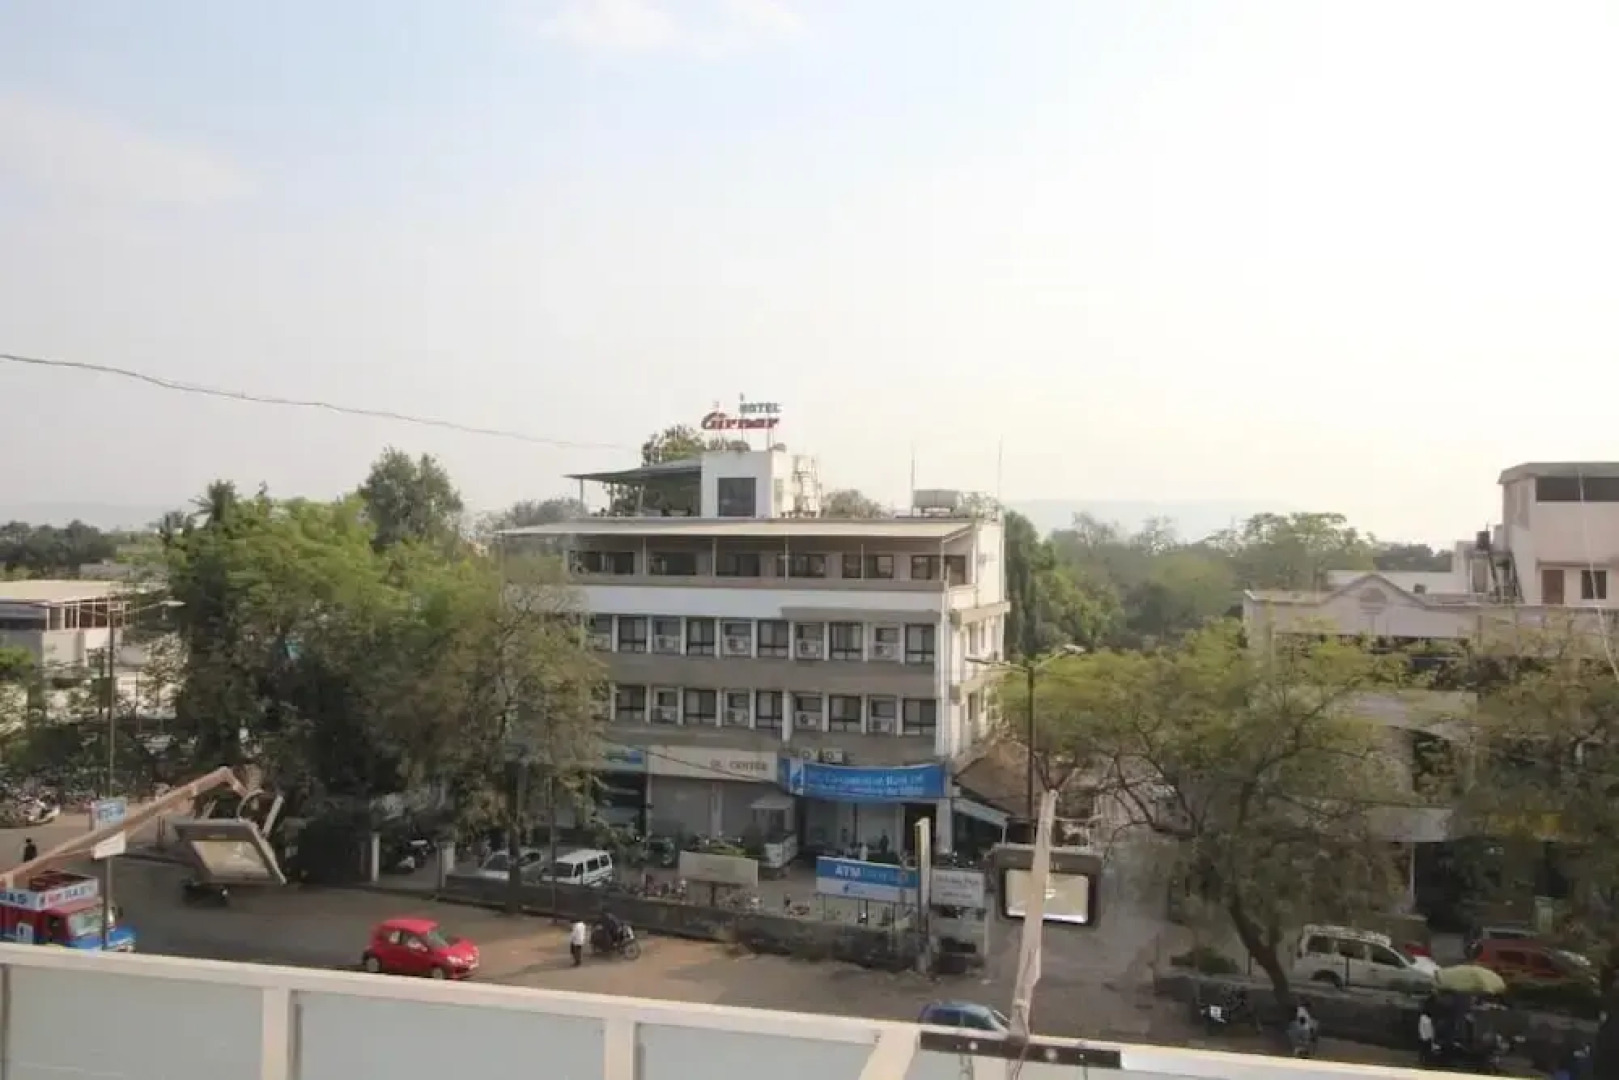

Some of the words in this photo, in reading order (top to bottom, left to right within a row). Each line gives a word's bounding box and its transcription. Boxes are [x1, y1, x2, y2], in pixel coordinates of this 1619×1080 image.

[739, 402, 782, 413] HOTEL
[701, 412, 780, 429] Girnar
[835, 864, 862, 878] ATM
